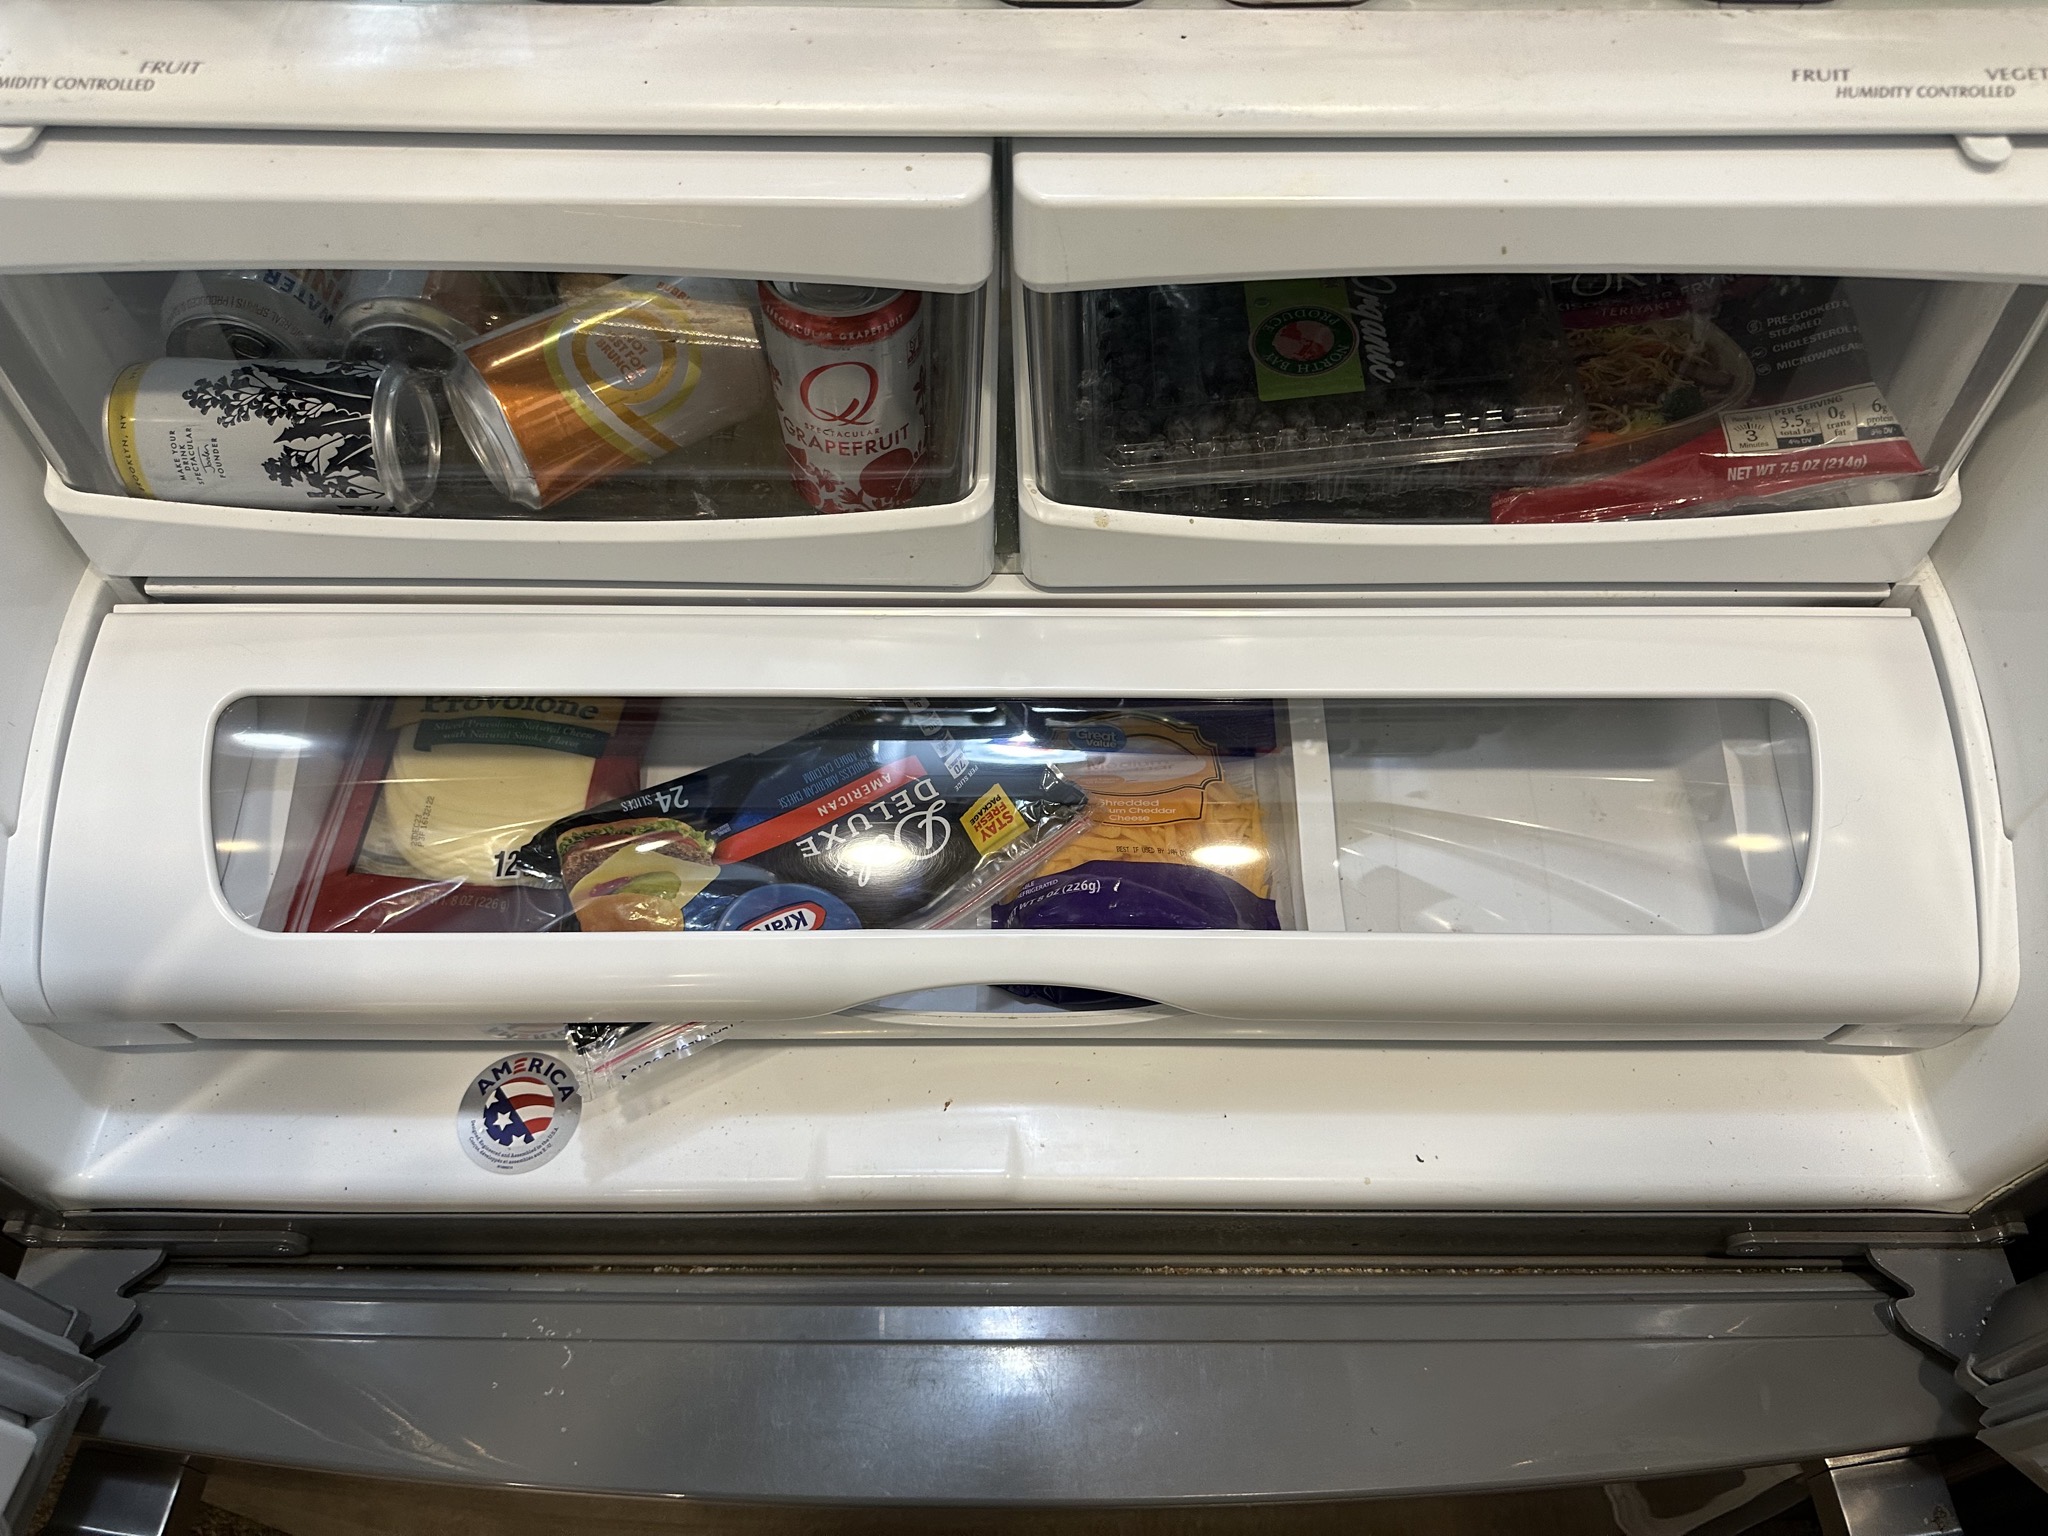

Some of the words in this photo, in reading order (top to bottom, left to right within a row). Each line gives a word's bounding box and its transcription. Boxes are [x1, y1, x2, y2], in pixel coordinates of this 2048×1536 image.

[139, 60, 205, 74] FRUIT
[1791, 68, 1850, 82] FRUIT
[1984, 67, 2048, 81] VEGET
[53, 77, 155, 91] CONTROLLED
[1836, 85, 1912, 98] HUMIDITY
[1916, 85, 2016, 98] CONTROLLED
[263, 269, 336, 330] WATER
[1602, 302, 1670, 317] TERIYAKI
[1264, 309, 1341, 332] PRODUCE
[1766, 300, 1841, 327] PRE-COOKED
[839, 313, 905, 341] GRAPEFRUIT
[1348, 277, 1404, 384] Organic
[1768, 317, 1822, 339] STEAMED
[1772, 325, 1852, 353] CHOLESTEROL
[1263, 353, 1291, 371] BAY
[1297, 344, 1351, 373] NORTH
[1776, 342, 1864, 371] MICROWAVEA
[800, 361, 879, 426] Q
[1774, 408, 1796, 417] PER
[1797, 395, 1843, 413] SERVING
[1828, 405, 1846, 420] 0g
[1872, 398, 1888, 414] 6g
[120, 415, 127, 429] NY
[804, 422, 881, 438] SPECTACULAR
[1780, 414, 1811, 429] 3.5g
[1802, 427, 1816, 435] fat
[1827, 420, 1851, 430] trans
[169, 430, 178, 455] YOUR
[783, 416, 910, 456] GRAPEFRUIT
[1745, 429, 1758, 442] 3
[1834, 429, 1847, 437] fat
[185, 427, 205, 485] SPECTACULAR
[1739, 441, 1769, 449] Minutes
[179, 444, 191, 471] DRINK
[211, 437, 226, 479] FOUNDER
[1727, 465, 1752, 481] NET
[1756, 463, 1776, 477] WT
[1780, 461, 1799, 474] 7.5
[1801, 459, 1821, 471] OZ
[1822, 455, 1867, 471] (214g)
[174, 458, 187, 481] MAKE
[420, 696, 600, 720] Provolone
[443, 730, 466, 739] with
[470, 730, 510, 739] Natural
[520, 721, 560, 734] Natural
[563, 727, 596, 739] Cheese
[1076, 729, 1117, 741] Great
[1086, 739, 1117, 748] Value
[953, 759, 966, 774] 70
[967, 764, 979, 777] PER
[805, 772, 839, 798] AMERICAN
[953, 774, 969, 792] SLICE
[621, 794, 653, 812] SLICES
[655, 784, 689, 813] 24
[817, 772, 893, 817] AMERICAN
[1100, 799, 1160, 807] Shredded
[796, 778, 940, 858] DELUXE
[970, 793, 1002, 826] PACKAGE
[973, 801, 1007, 833] FRESH
[1108, 814, 1150, 822] Cheese
[980, 810, 1014, 843] STAY
[1116, 845, 1130, 853] BEST
[1141, 846, 1155, 854] USED
[494, 850, 520, 877] 12
[459, 894, 475, 906] OZ
[1019, 898, 1036, 910] WT
[1046, 887, 1061, 898] OZ
[1061, 879, 1101, 894] (226g)
[478, 1057, 575, 1103] AMERICA
